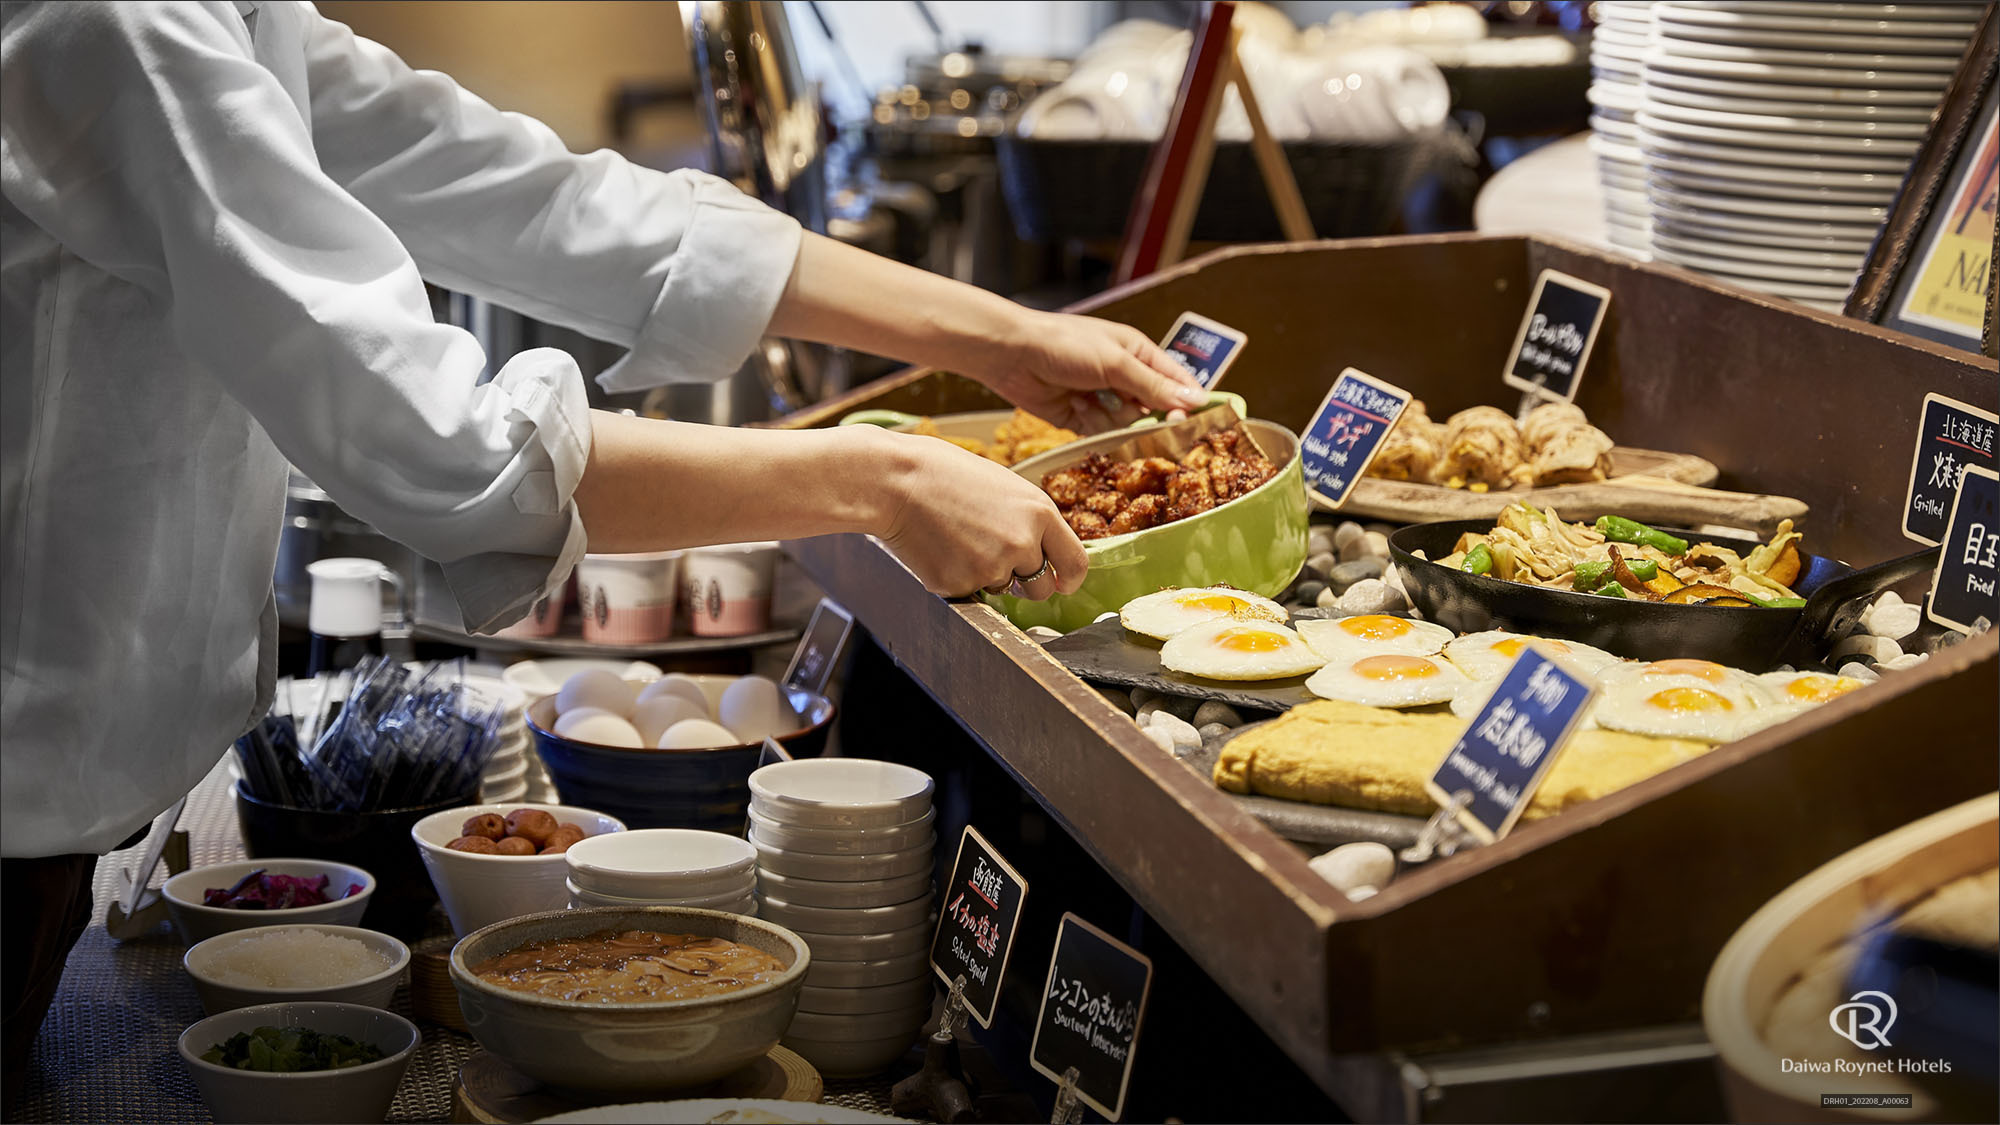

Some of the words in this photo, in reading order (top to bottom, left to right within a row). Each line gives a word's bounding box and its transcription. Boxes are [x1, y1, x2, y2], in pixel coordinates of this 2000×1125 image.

[1944, 250, 1989, 296] NA
[1327, 411, 1373, 452] ザンギ
[1942, 413, 1995, 453] 北海道産
[1913, 493, 1945, 519] Grilled
[1963, 523, 1999, 568] 目玉
[1966, 573, 1995, 597] Fried
[973, 856, 1003, 904] 函館産
[949, 892, 1000, 958] イカの塩辛
